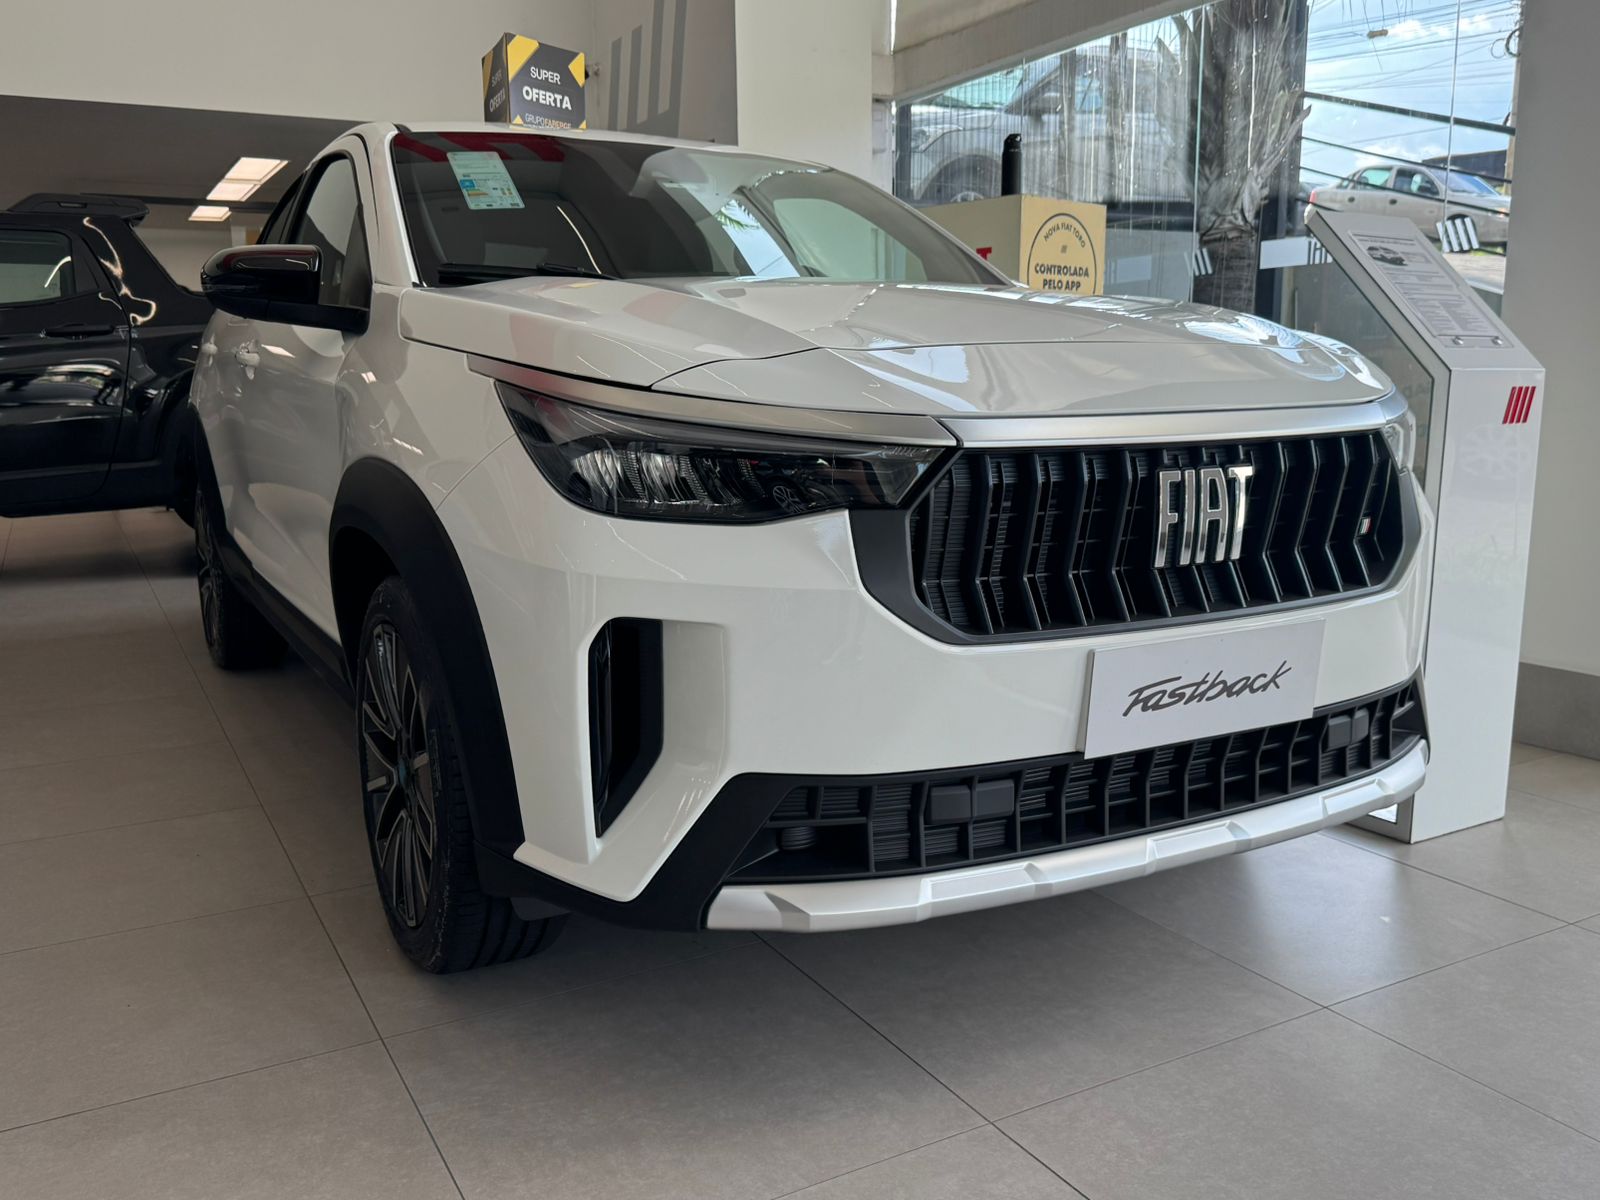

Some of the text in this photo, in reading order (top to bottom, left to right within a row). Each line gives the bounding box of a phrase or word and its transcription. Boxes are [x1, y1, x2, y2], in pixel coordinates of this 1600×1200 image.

[530, 66, 561, 85] SUPER
[522, 85, 572, 111] OFERTA
[1043, 222, 1086, 249] NOVA FIAT TORO
[1034, 263, 1089, 278] CONTROLADA
[1042, 279, 1081, 292] PELO APP
[1154, 466, 1253, 568] FIAT
[1122, 660, 1292, 717] Fastback
